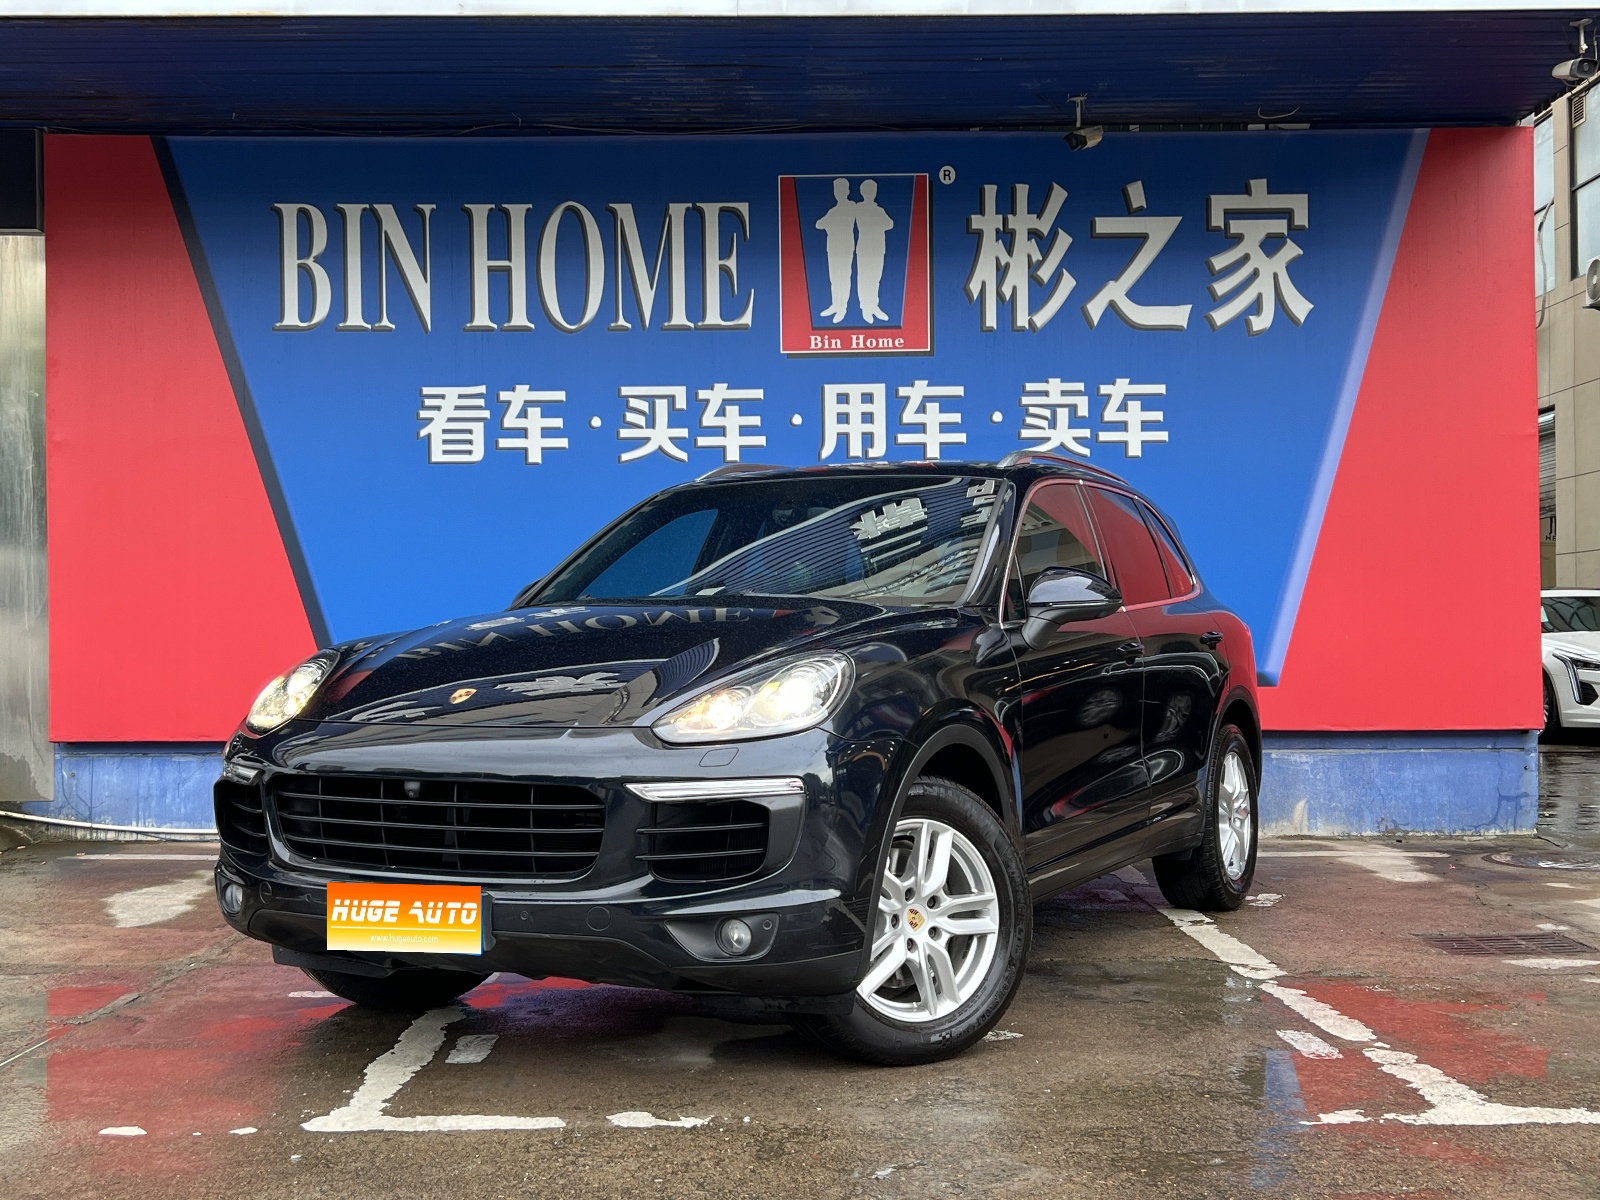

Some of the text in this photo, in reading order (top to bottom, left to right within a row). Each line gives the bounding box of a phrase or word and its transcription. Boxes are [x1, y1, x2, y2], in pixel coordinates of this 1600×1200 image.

[272, 201, 754, 333] BIN HOME
[963, 178, 1314, 336] 彬之家
[810, 334, 905, 349] Bin Home
